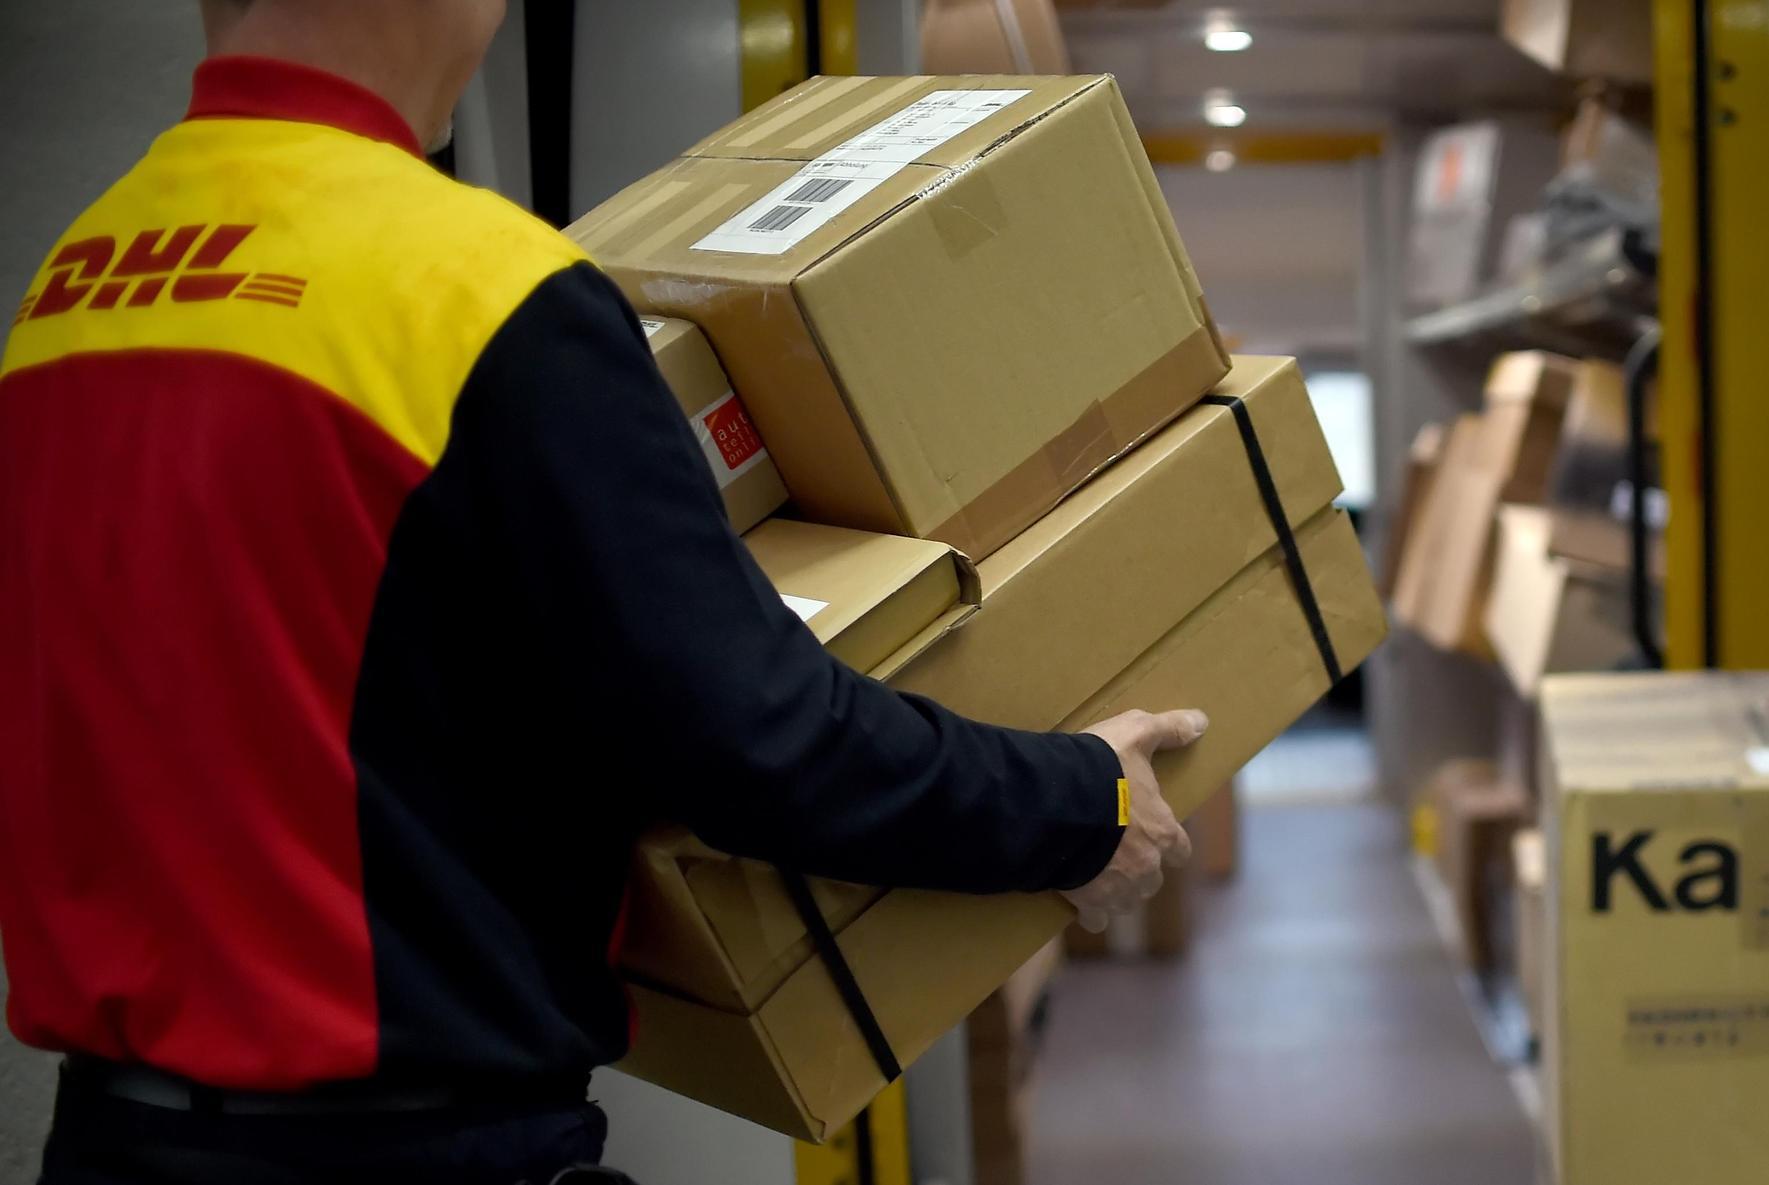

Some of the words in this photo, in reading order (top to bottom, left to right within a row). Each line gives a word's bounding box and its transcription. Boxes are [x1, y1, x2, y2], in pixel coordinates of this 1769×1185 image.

[27, 223, 257, 319] DHL
[717, 412, 747, 441] aut
[729, 437, 757, 464] onli
[1591, 829, 1739, 914] Ka
